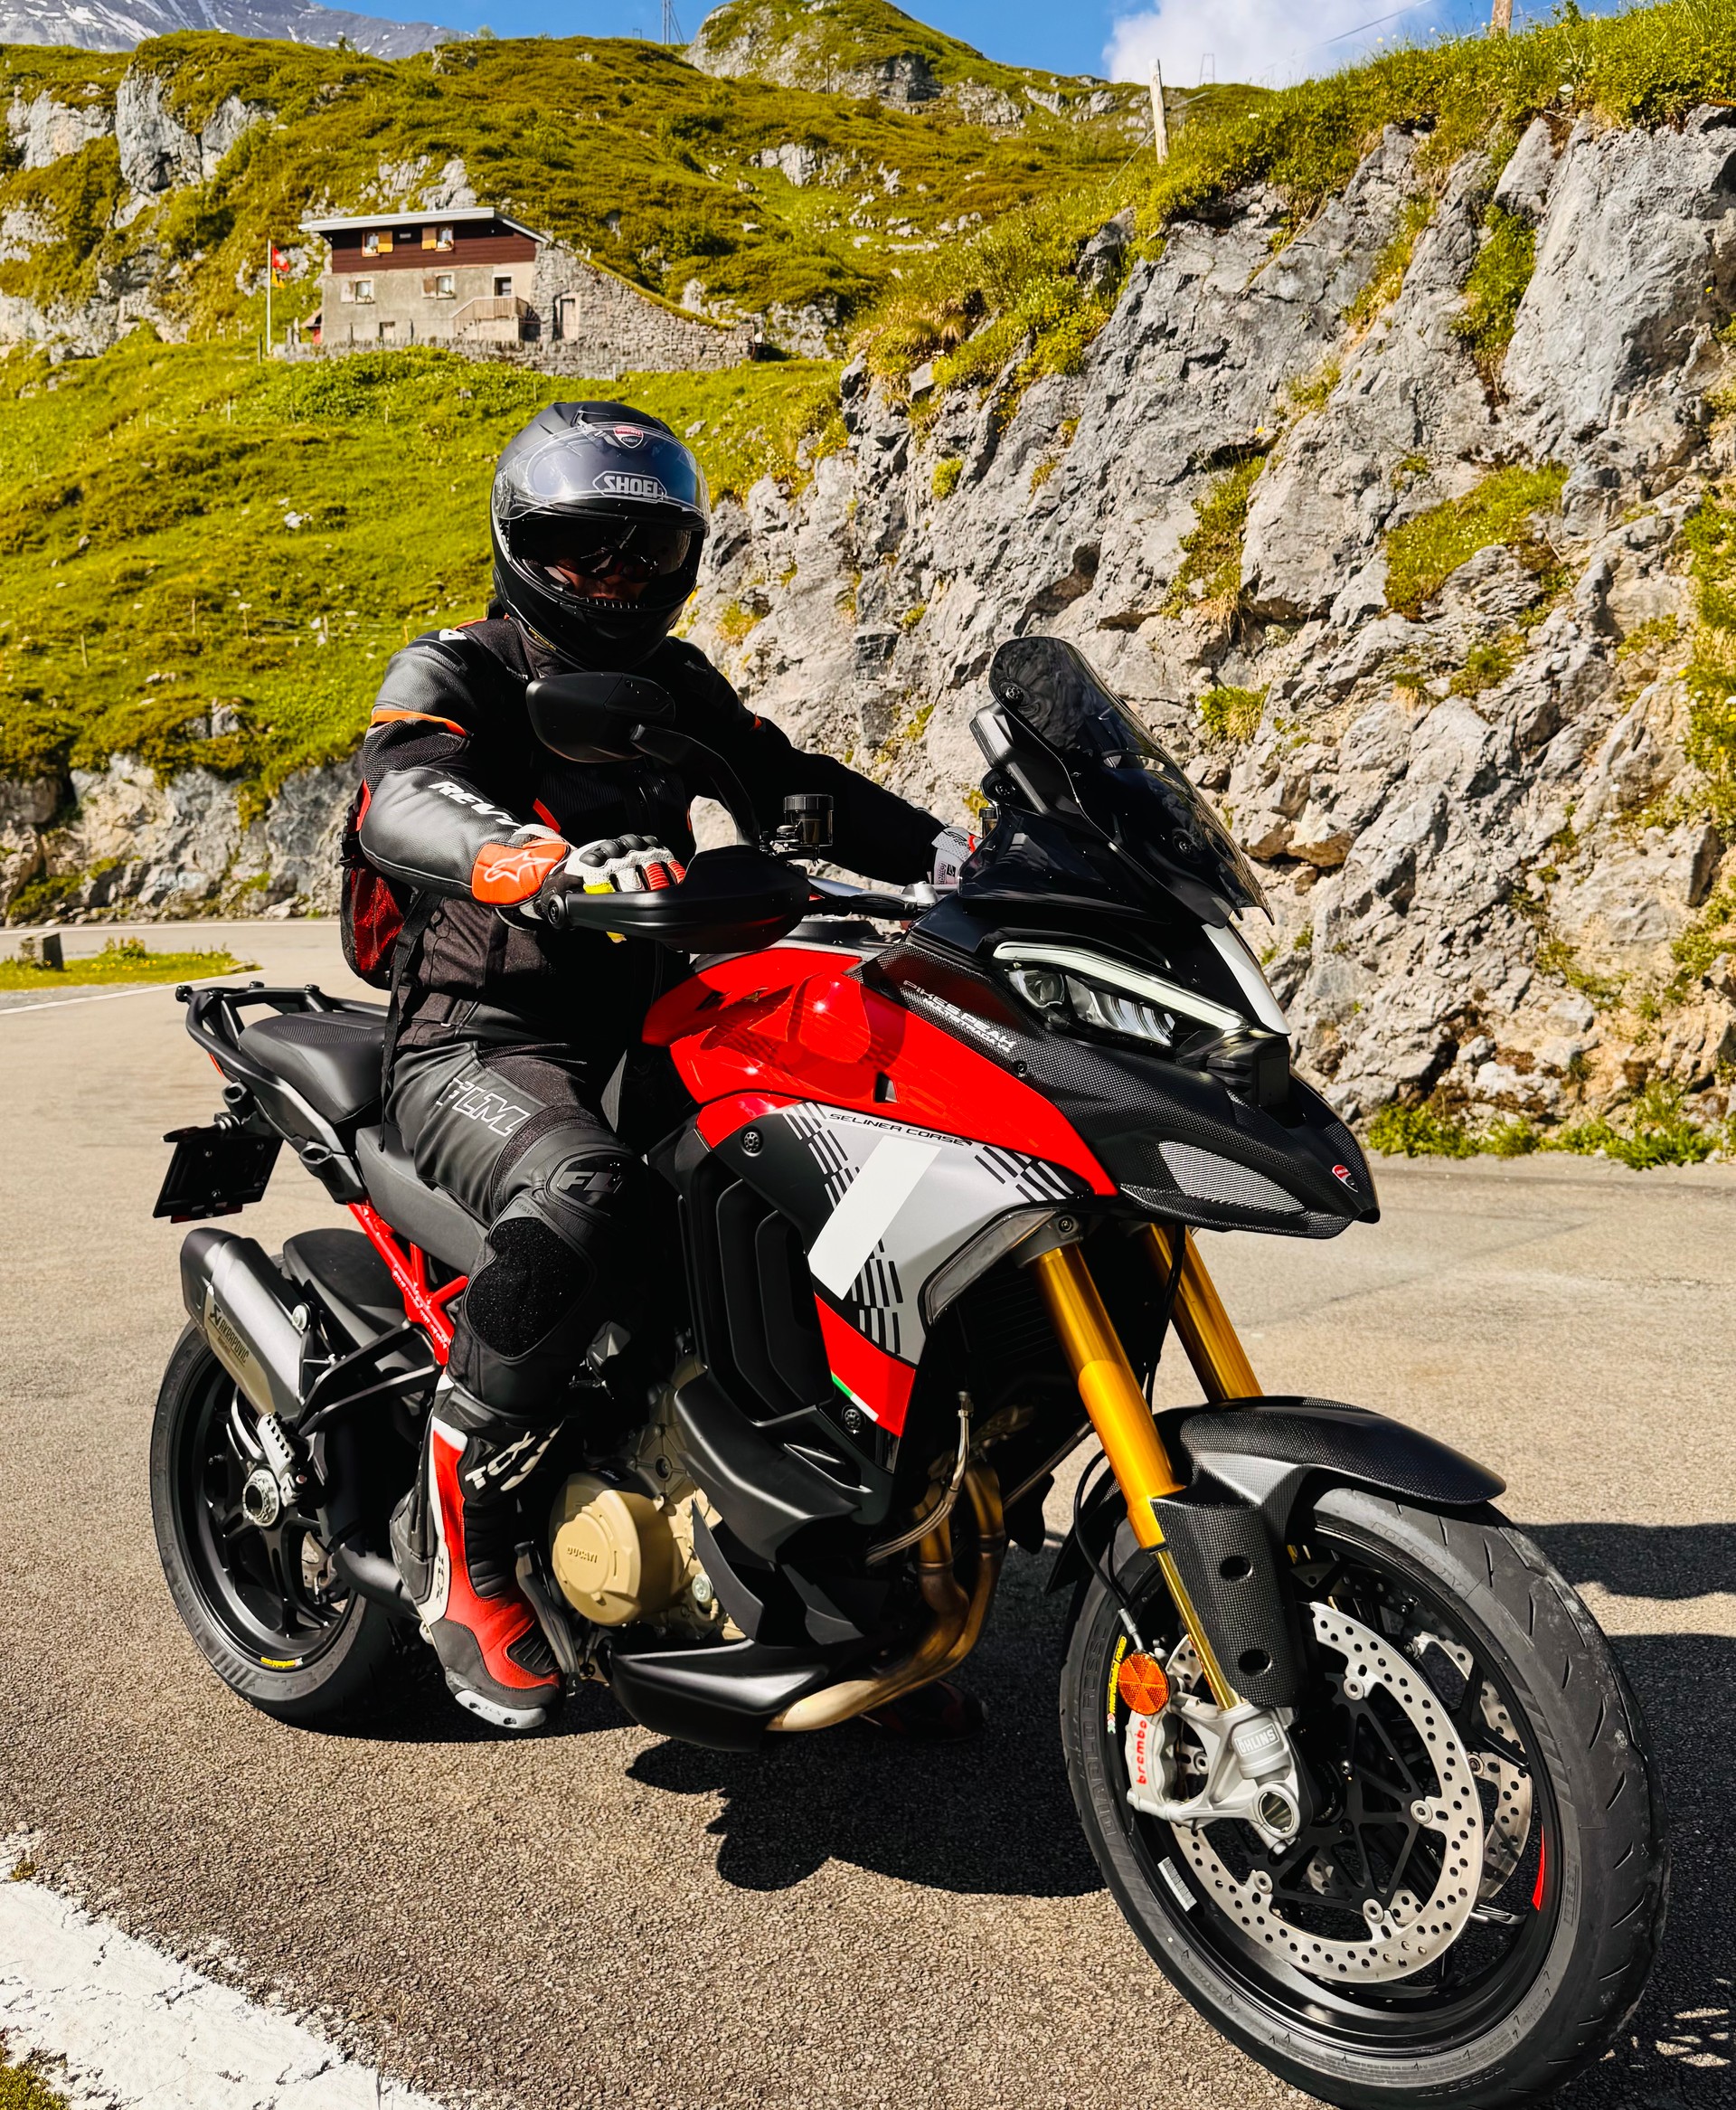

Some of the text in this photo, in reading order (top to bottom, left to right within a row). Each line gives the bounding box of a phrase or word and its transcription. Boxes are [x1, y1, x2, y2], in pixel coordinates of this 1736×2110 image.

[603, 475, 658, 498] SHOEI
[903, 979, 1016, 1048] PIKES PEAK
[829, 1113, 965, 1147] SELINER CORSE
[465, 1430, 536, 1490] TCX
[567, 1546, 599, 1564] DUCATI
[1134, 1719, 1148, 1785] brembo
